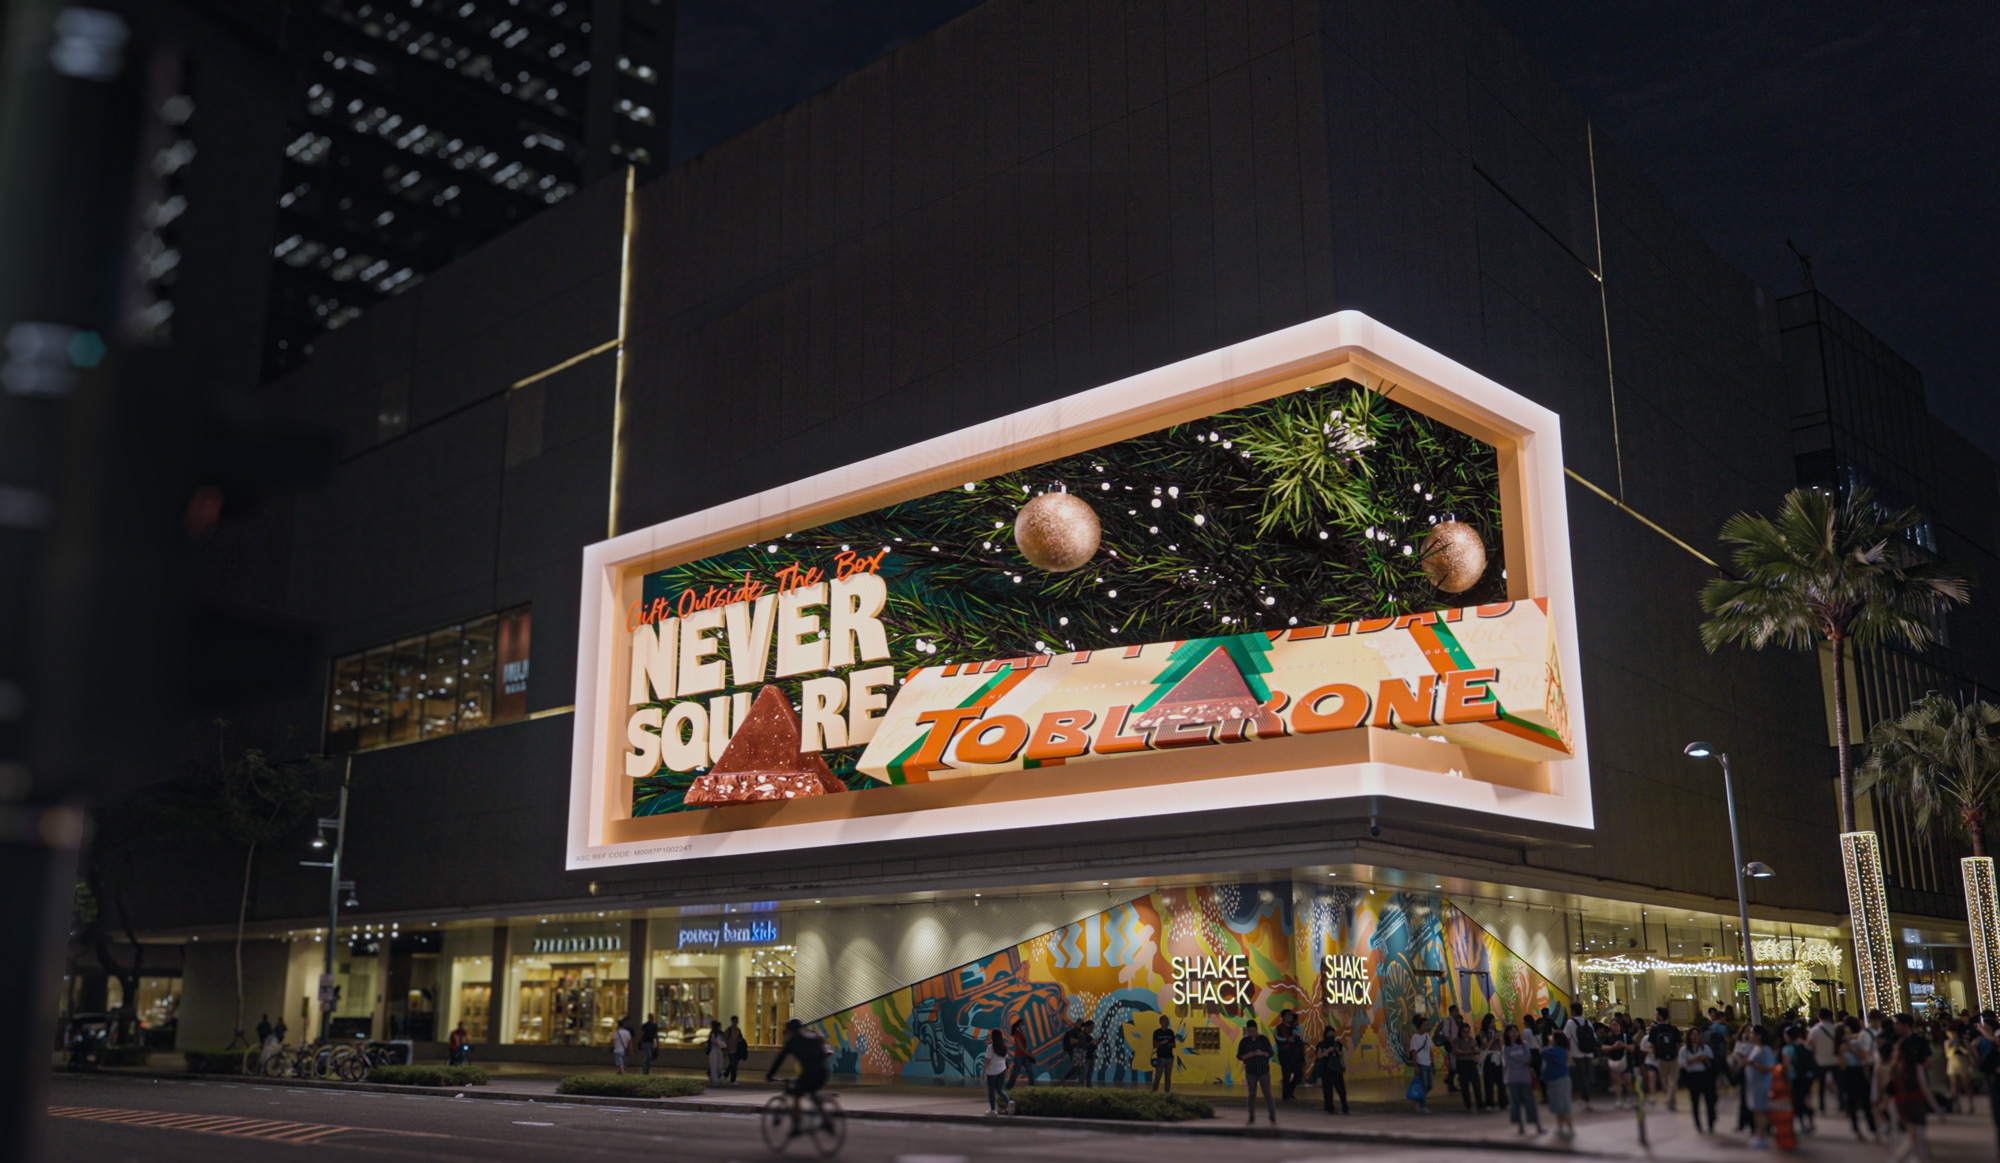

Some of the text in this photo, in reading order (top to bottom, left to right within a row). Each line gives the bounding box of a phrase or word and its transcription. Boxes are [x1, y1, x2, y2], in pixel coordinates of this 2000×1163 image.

[627, 550, 887, 633] Gift Outside The Box
[629, 573, 892, 705] NEVER
[575, 854, 591, 862] ASC
[592, 853, 607, 861] REF
[1171, 954, 1247, 980] SHAKE
[1325, 954, 1369, 980] SHAKE
[1172, 980, 1251, 1005] SHACK
[1326, 980, 1372, 1005] SHACK
